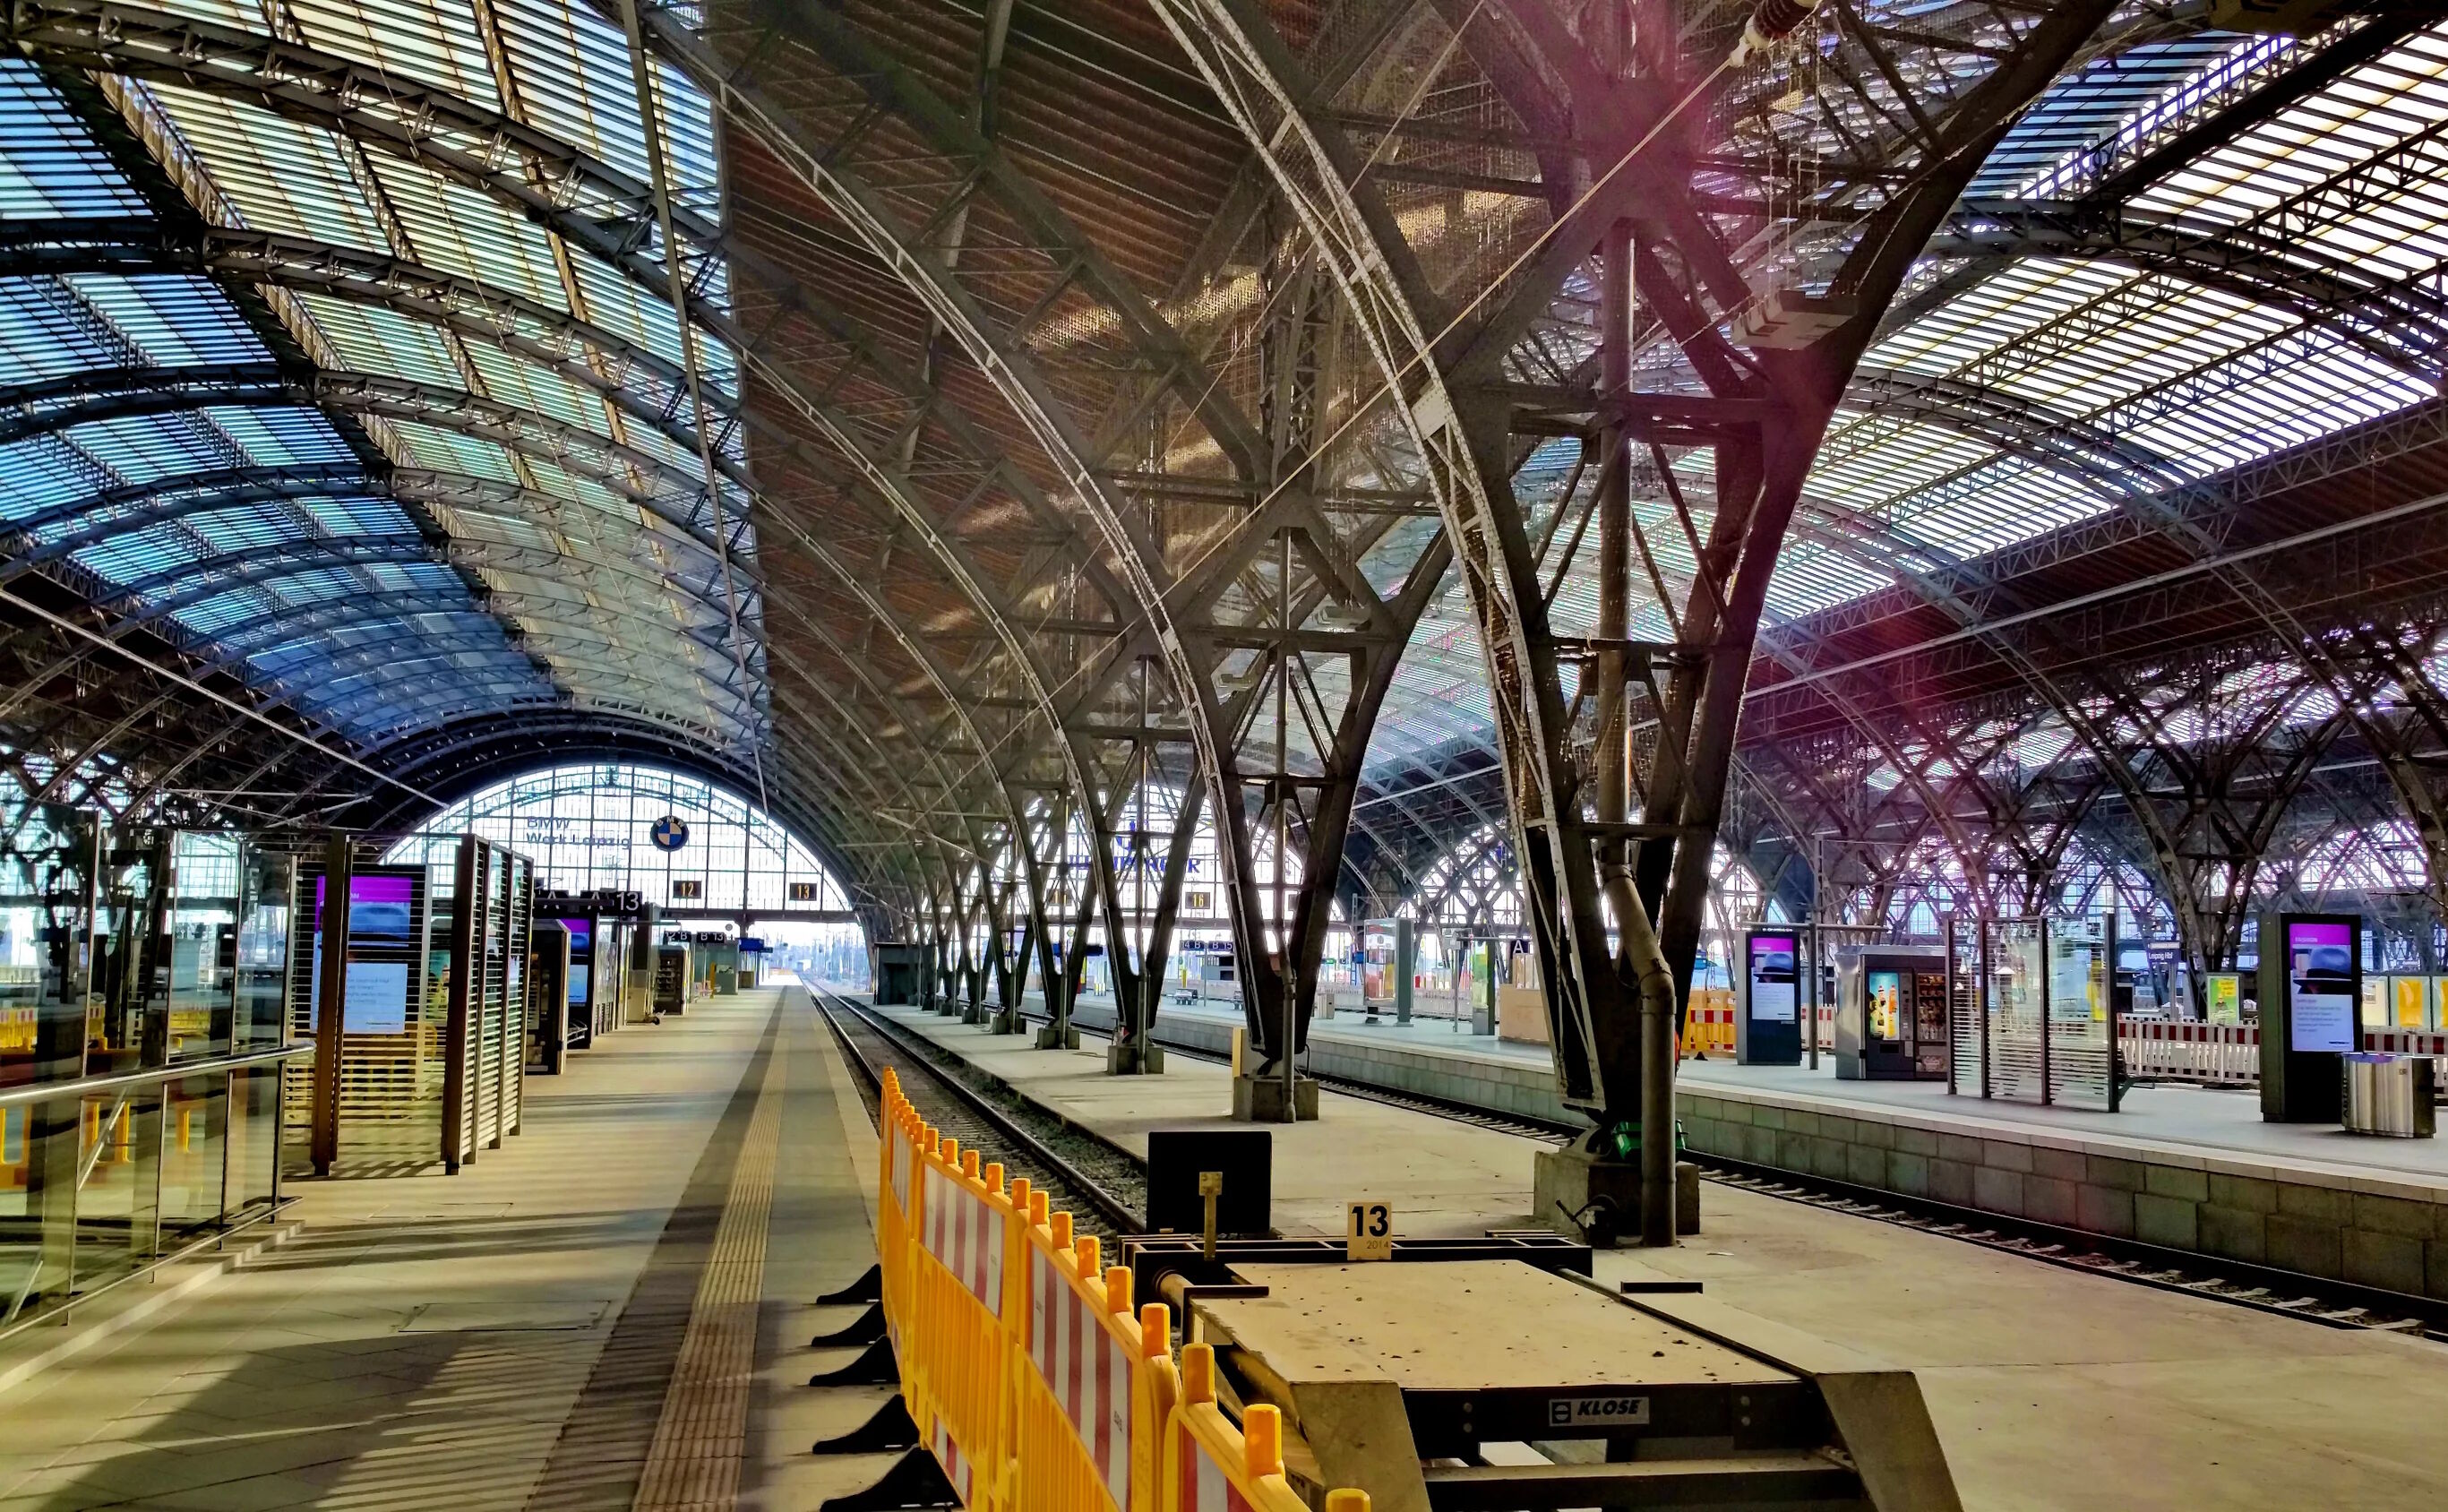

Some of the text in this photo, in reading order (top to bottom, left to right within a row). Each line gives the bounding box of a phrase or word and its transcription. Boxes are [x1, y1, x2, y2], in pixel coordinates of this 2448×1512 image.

[527, 817, 571, 829] BMW
[656, 816, 686, 828] BMW
[527, 832, 631, 850] Werk Leipzig
[681, 882, 694, 893] 12
[797, 885, 810, 896] 13
[616, 891, 639, 911] 13
[1193, 895, 1205, 906] 16
[681, 932, 688, 941] B
[700, 932, 724, 941] B 13
[1194, 940, 1201, 949] B
[1212, 941, 1219, 949] B
[1513, 940, 1525, 954] A
[1352, 1205, 1389, 1238] 13
[1577, 1399, 1642, 1416] KLOSE
